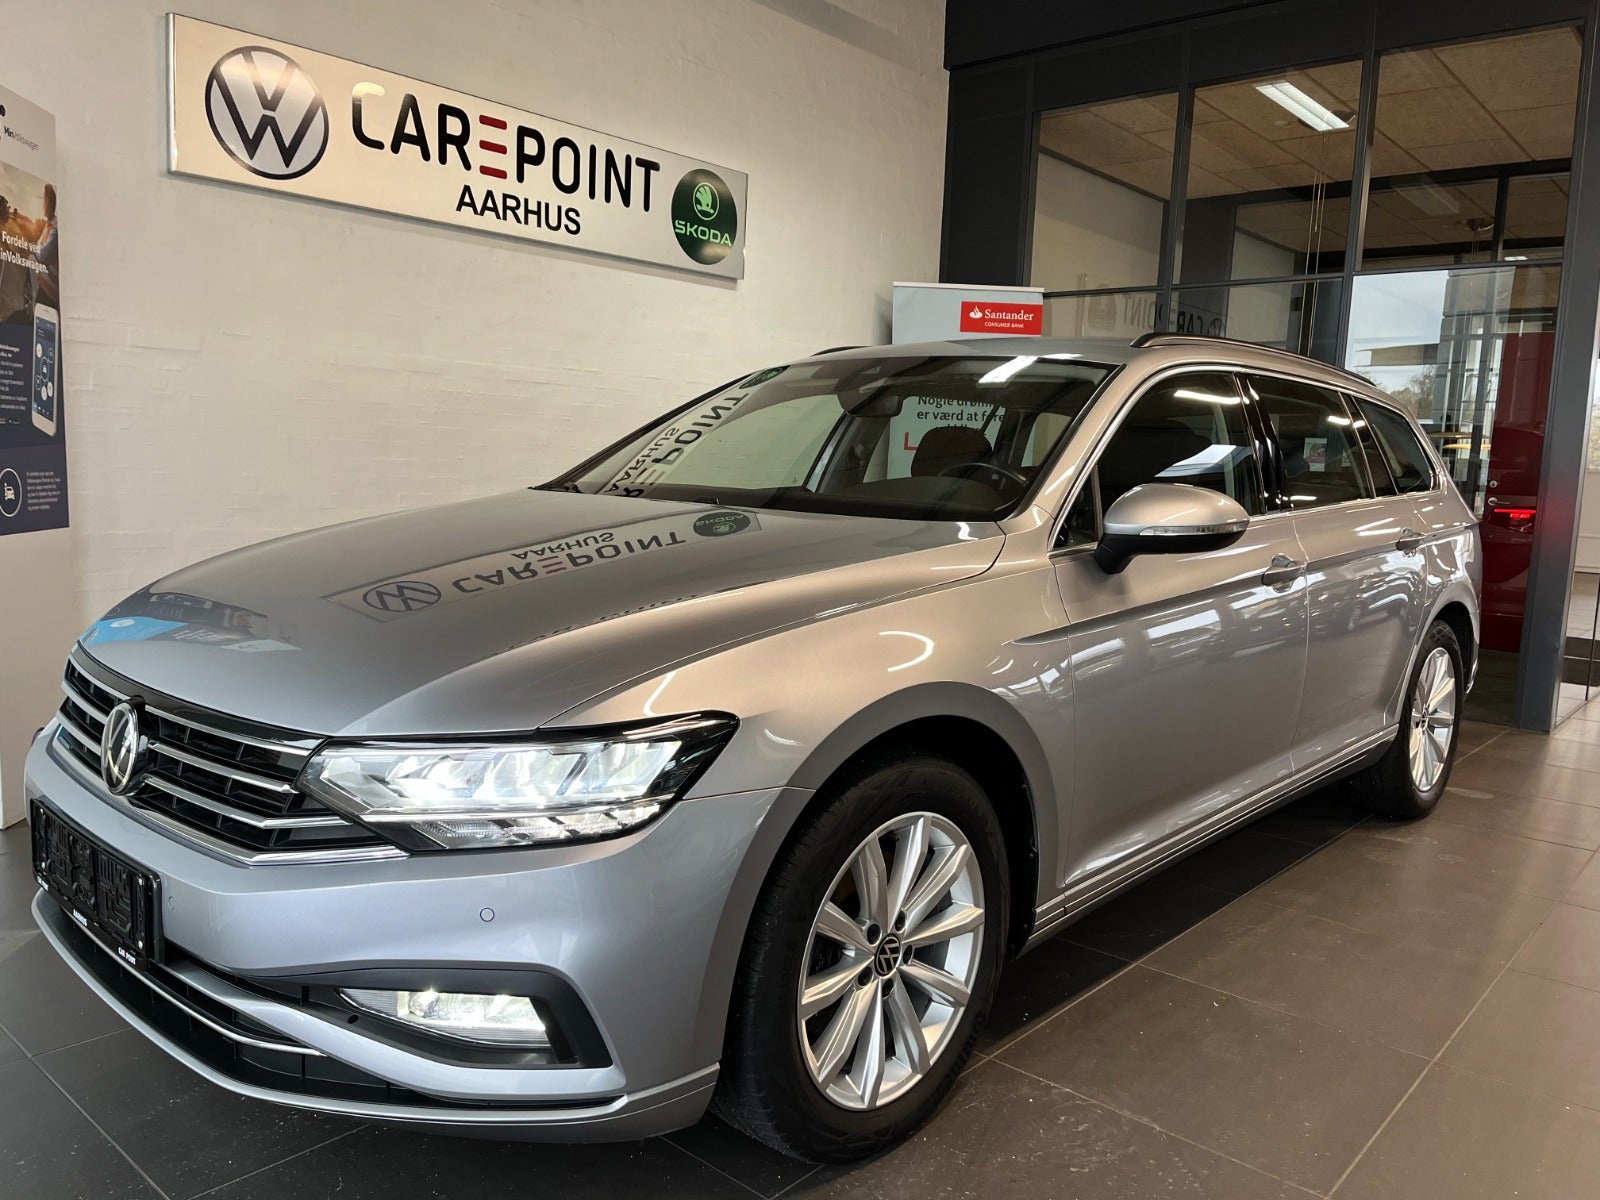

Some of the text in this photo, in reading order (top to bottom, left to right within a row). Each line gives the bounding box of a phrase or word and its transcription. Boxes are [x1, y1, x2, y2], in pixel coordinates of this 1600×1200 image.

[351, 81, 661, 212] CAREPOINT
[455, 184, 581, 235] AARHUS
[2, 230, 28, 250] Fordele
[0, 248, 49, 274] inVolkswagen.
[984, 308, 1034, 321] Santander
[917, 409, 1005, 422] er værd at fre
